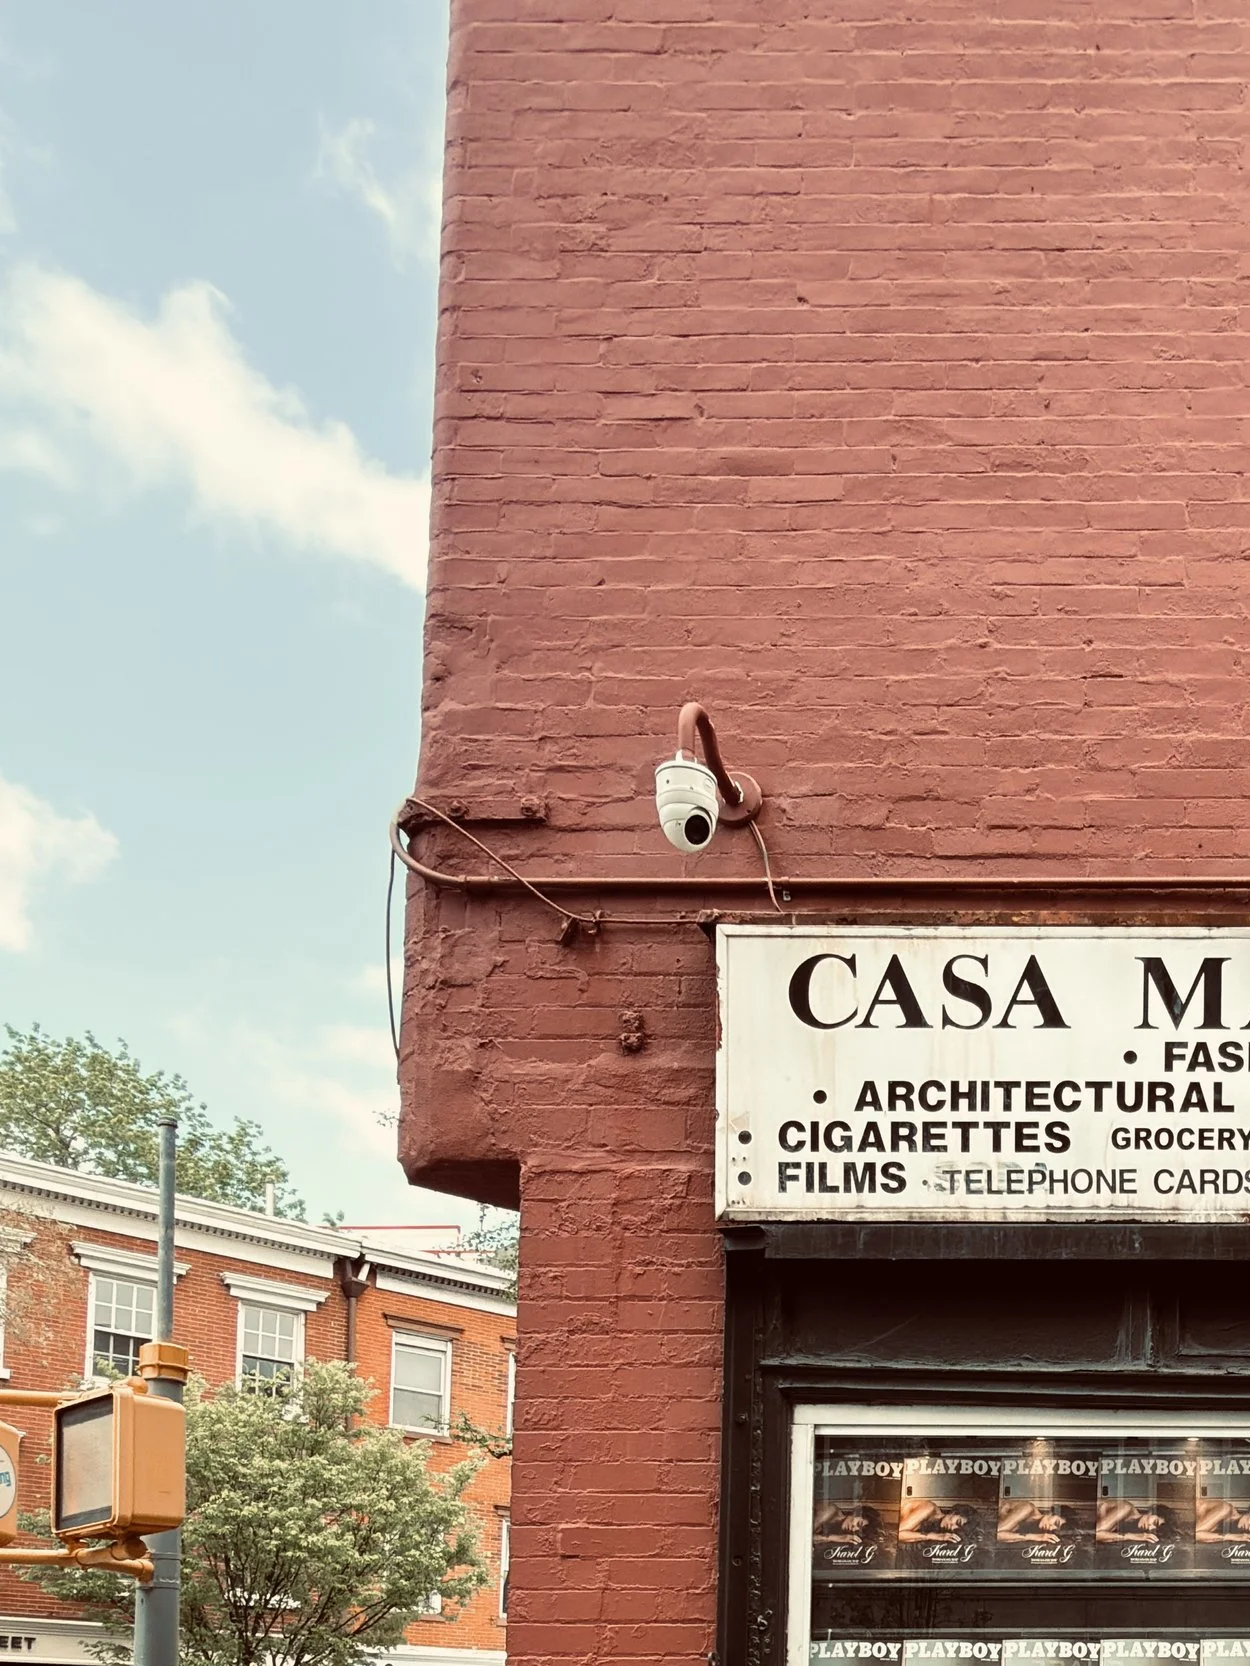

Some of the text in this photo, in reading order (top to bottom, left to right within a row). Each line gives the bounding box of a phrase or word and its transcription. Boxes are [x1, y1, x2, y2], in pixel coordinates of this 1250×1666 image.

[788, 953, 1072, 1030] CASA
[854, 1080, 1235, 1114] ARCHITECTURAL
[777, 1120, 1072, 1155] CIGARETTES
[777, 1161, 907, 1195] FILMS
[941, 1168, 1138, 1196] TELEPHONE
[815, 1461, 903, 1478] PLAYBOY
[905, 1458, 1000, 1476] PLAYBOY
[1004, 1459, 1099, 1477] PLAYBOY
[1102, 1459, 1198, 1477] PLAYBOY
[810, 1642, 901, 1659] PLAYBOY
[905, 1642, 1002, 1659] PLAYBOY
[1004, 1642, 1101, 1659] PLAYBOY
[1104, 1642, 1200, 1659] PLAYBOY
